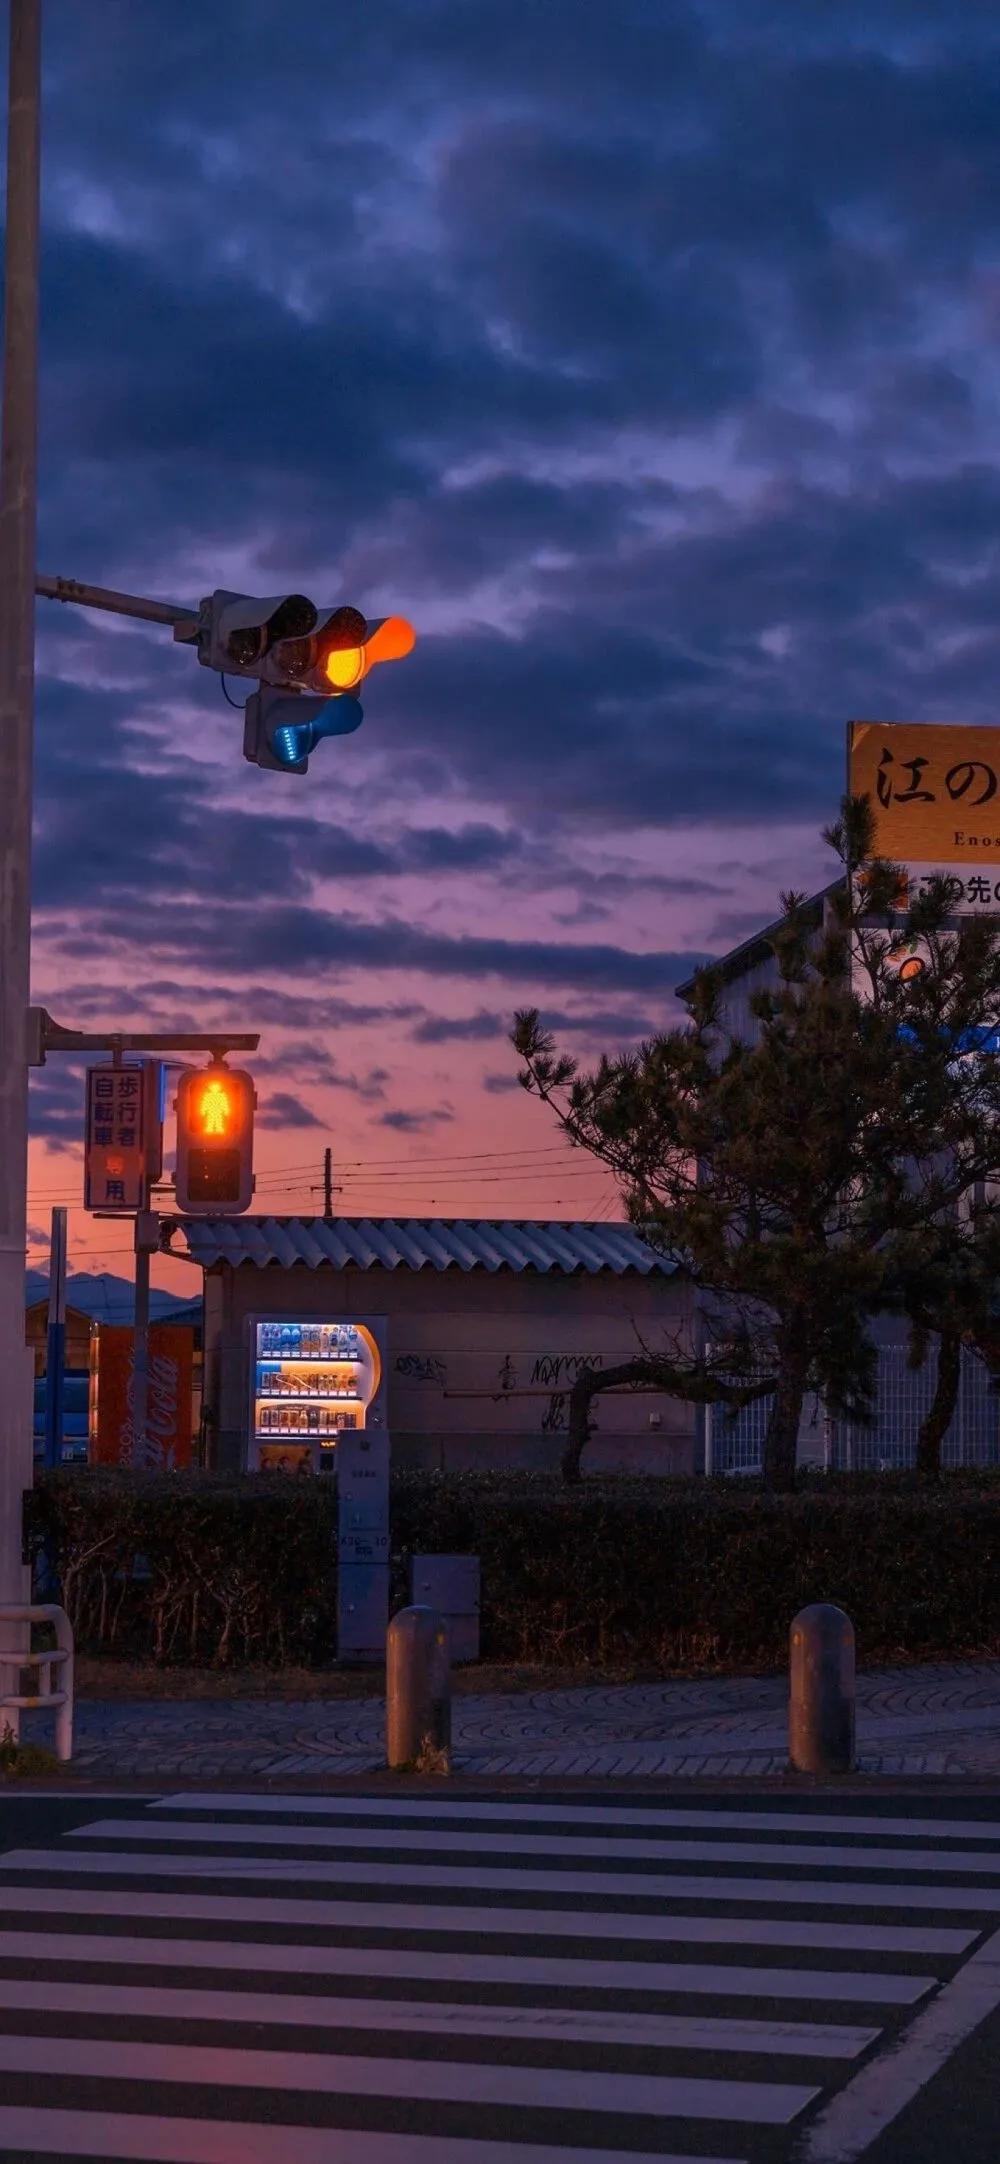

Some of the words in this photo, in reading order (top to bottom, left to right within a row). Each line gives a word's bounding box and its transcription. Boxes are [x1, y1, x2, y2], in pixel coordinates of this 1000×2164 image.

[876, 748, 998, 809] 江の
[95, 1078, 114, 1147] 自転車
[117, 1077, 138, 1146] 歩行者
